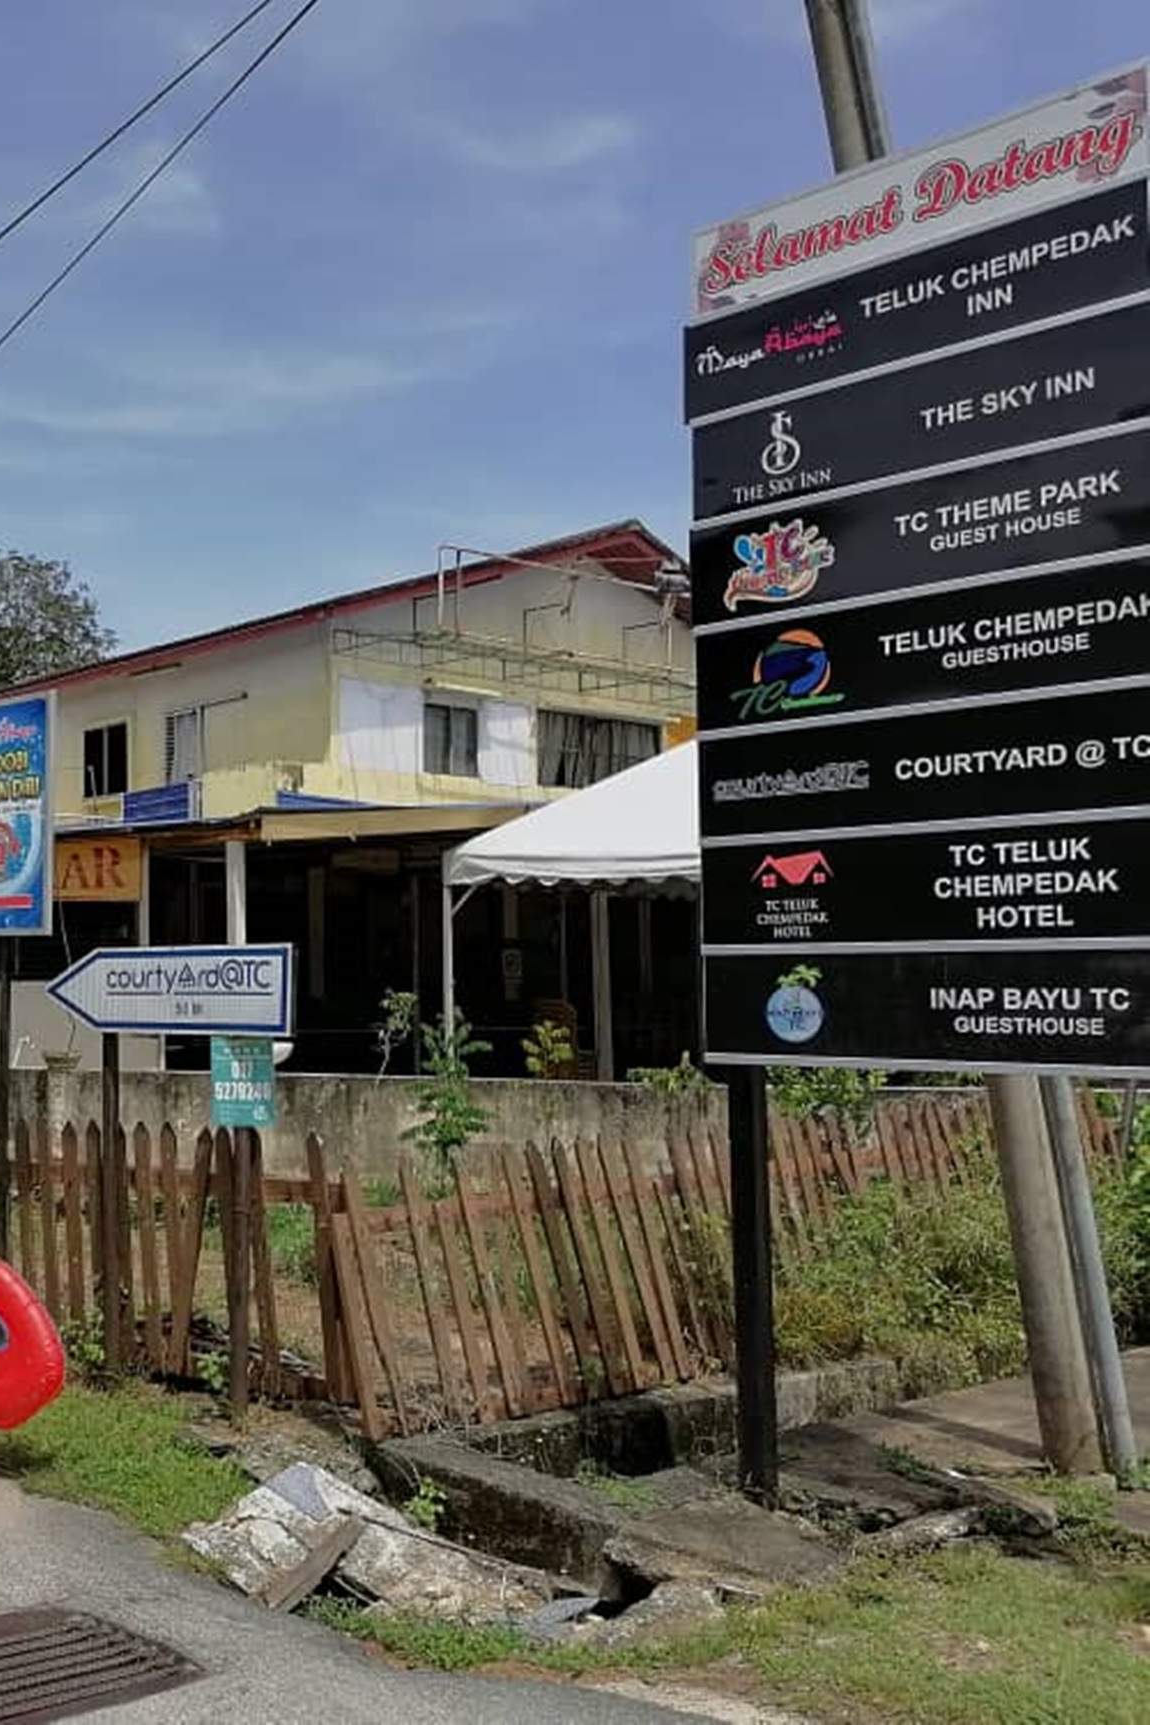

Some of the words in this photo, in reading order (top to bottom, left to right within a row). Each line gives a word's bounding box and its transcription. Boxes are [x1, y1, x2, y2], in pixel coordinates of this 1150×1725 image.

[705, 187, 902, 293] Selamat
[913, 112, 1141, 222] Datang
[859, 275, 946, 319] TELUK
[951, 214, 1136, 291] CHEMPEDAK
[967, 284, 1014, 317] INN
[921, 399, 975, 431] THE
[981, 381, 1038, 416] SKY
[1045, 367, 1097, 400] INN
[733, 485, 765, 505] THE
[768, 476, 797, 497] SKY
[800, 468, 833, 489] INN
[894, 512, 930, 537] TC
[935, 490, 1032, 529] THEME
[1040, 469, 1122, 508] PARK
[929, 524, 999, 553] GUEST
[1005, 507, 1082, 539] HOUSE
[878, 625, 967, 657] TELUK
[941, 632, 1091, 671] GUESTHOUSE
[895, 743, 1068, 781] COURTYARD
[1075, 741, 1107, 768] @
[1112, 733, 1150, 760] TC
[948, 845, 987, 866] TC
[998, 837, 1092, 866] TELUK
[933, 868, 1120, 900] CHEMPEDAK
[765, 900, 781, 912] TC
[784, 899, 819, 911] TELUK
[976, 905, 1075, 930] HOTEL
[773, 926, 812, 938] HOTEL
[930, 988, 996, 1010] INAP
[1003, 988, 1084, 1010] BAYU
[1090, 988, 1131, 1012] TC
[953, 1017, 1105, 1036] GUESTHOUSE
